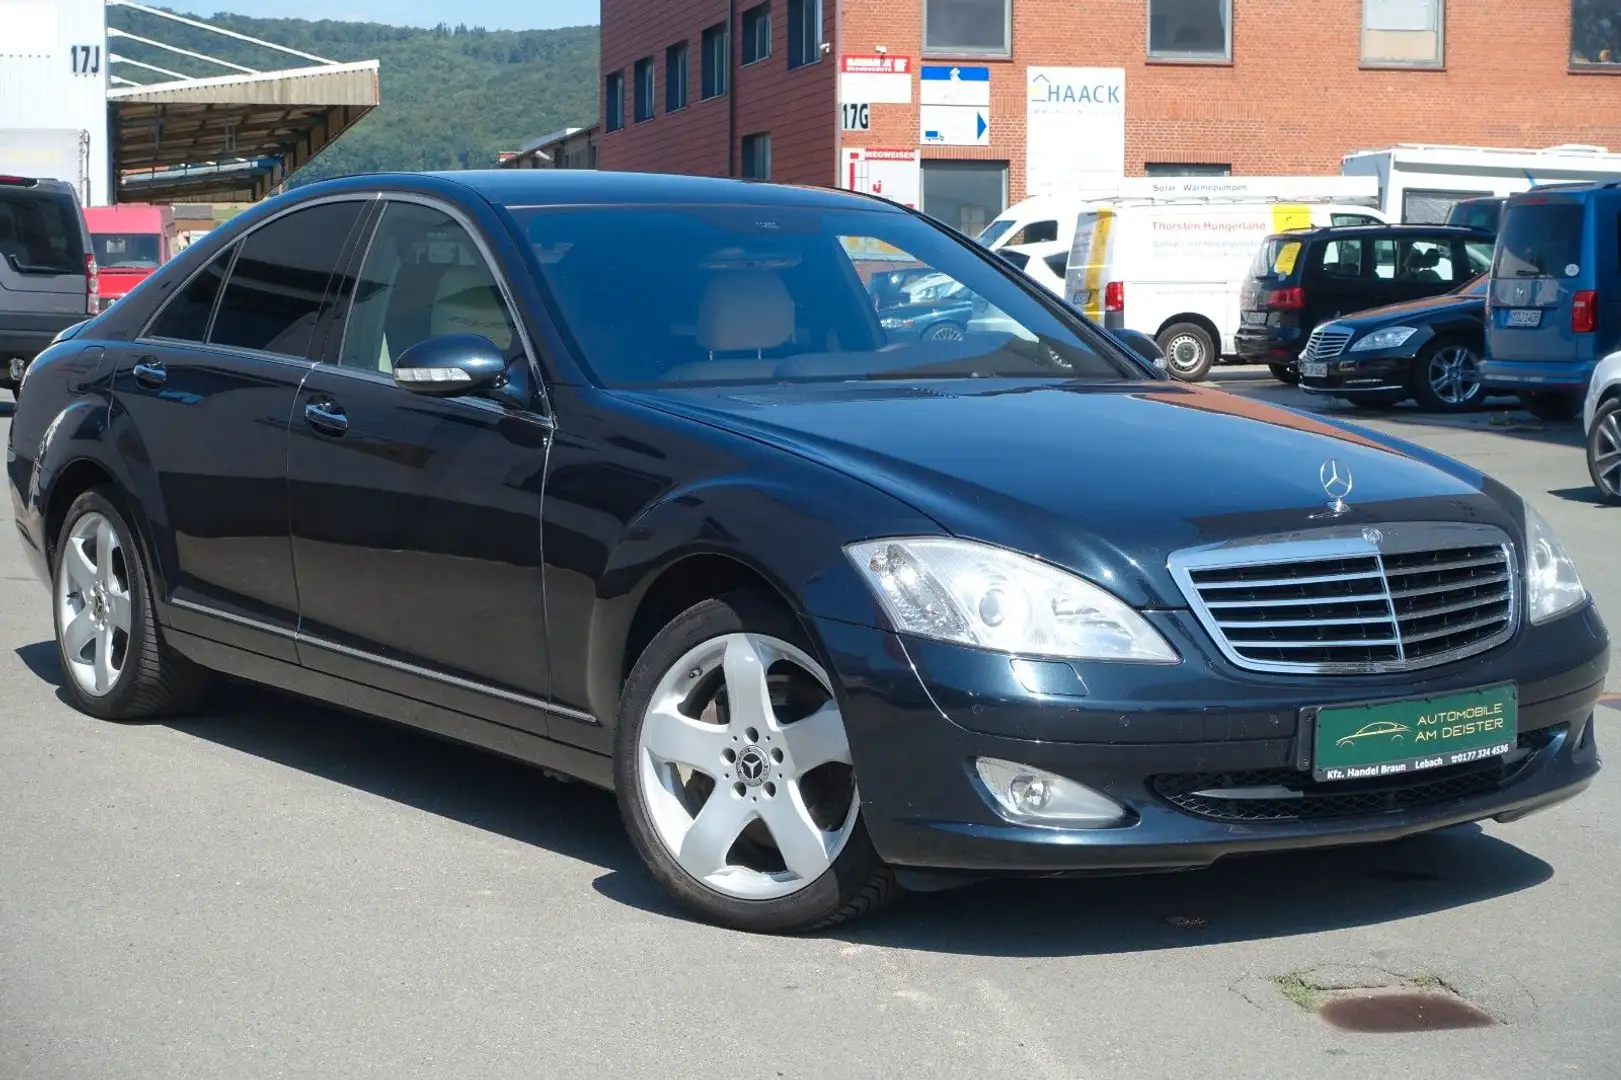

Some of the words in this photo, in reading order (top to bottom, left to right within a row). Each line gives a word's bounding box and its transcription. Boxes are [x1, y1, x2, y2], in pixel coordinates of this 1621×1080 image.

[71, 46, 101, 73] 17J
[1047, 85, 1120, 104] HAACK
[843, 103, 869, 129] 17G
[865, 151, 915, 159] WEGWEISER
[1153, 184, 1176, 192] Solar
[1152, 221, 1201, 231] Thorsten
[1203, 221, 1266, 233] Hungerland
[1417, 703, 1503, 726] AUTOMOBILE
[1415, 730, 1437, 742] AM
[1442, 718, 1504, 738] DEISTER
[1327, 769, 1345, 780] Kfz.
[1347, 766, 1379, 777] Handel
[1381, 763, 1406, 774] Braun
[1415, 757, 1443, 769] Lebach
[1477, 748, 1491, 759] 324
[1491, 744, 1509, 756] 4536
